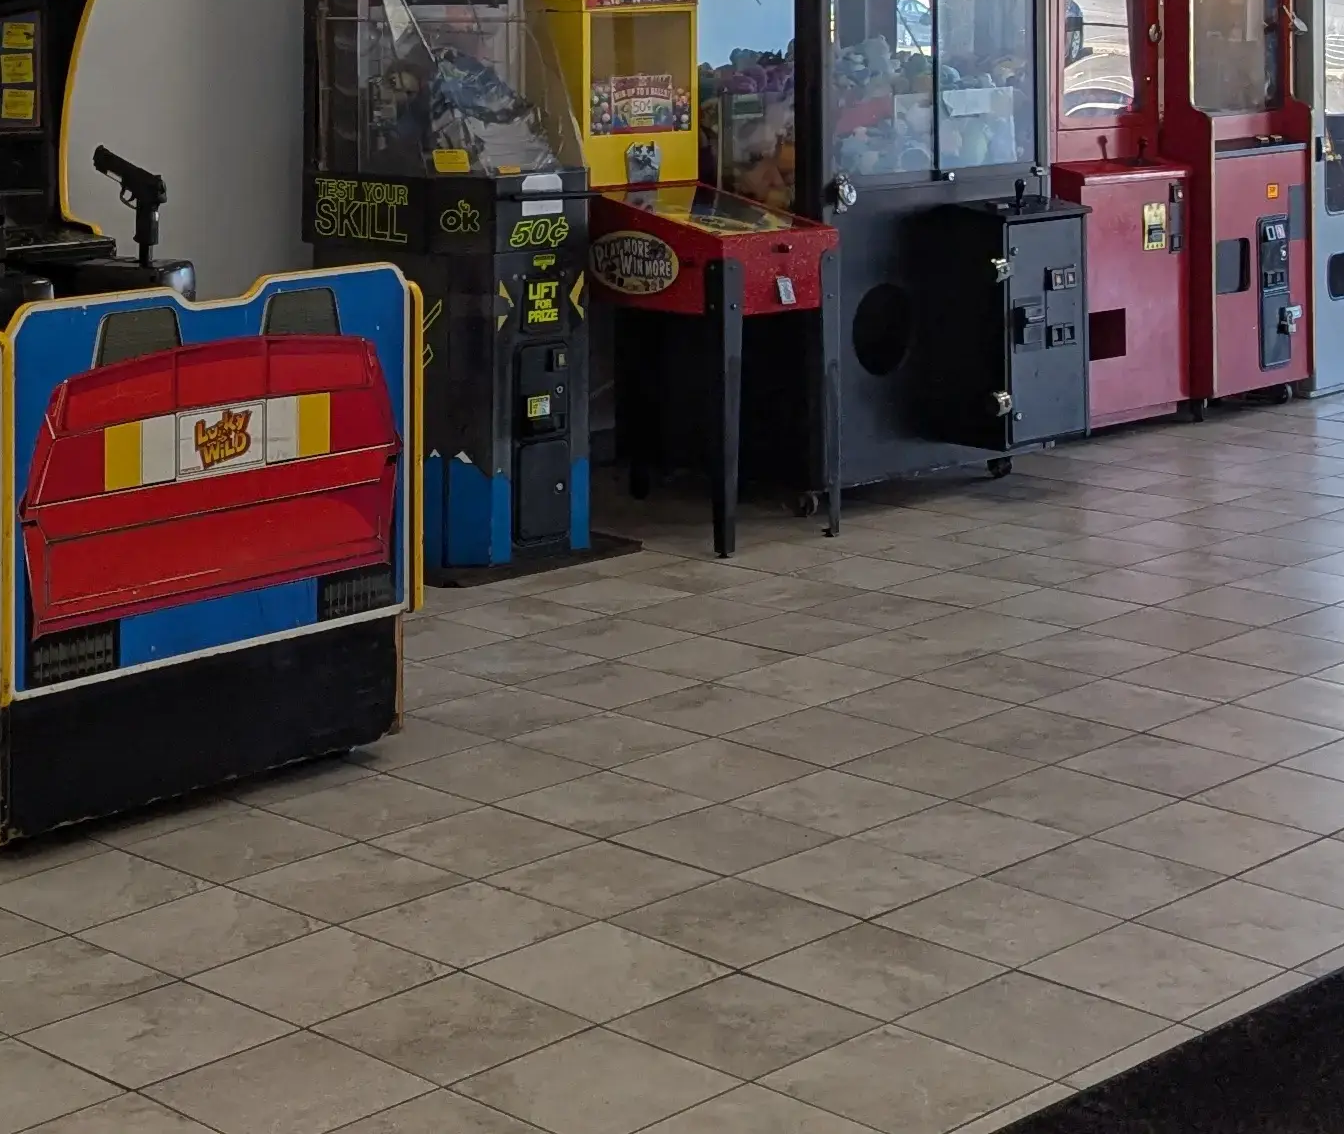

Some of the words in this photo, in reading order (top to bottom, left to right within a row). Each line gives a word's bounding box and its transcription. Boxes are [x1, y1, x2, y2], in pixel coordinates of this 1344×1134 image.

[314, 177, 358, 201] TEST
[361, 181, 409, 205] YOUR
[314, 197, 408, 244] SKILL
[509, 216, 570, 248] 50¢
[623, 238, 650, 259] MORE
[619, 248, 644, 276] WIN
[644, 259, 672, 278] MORE
[527, 281, 559, 300] LIFT
[527, 309, 559, 324] PRIZE
[534, 299, 553, 310] FOR
